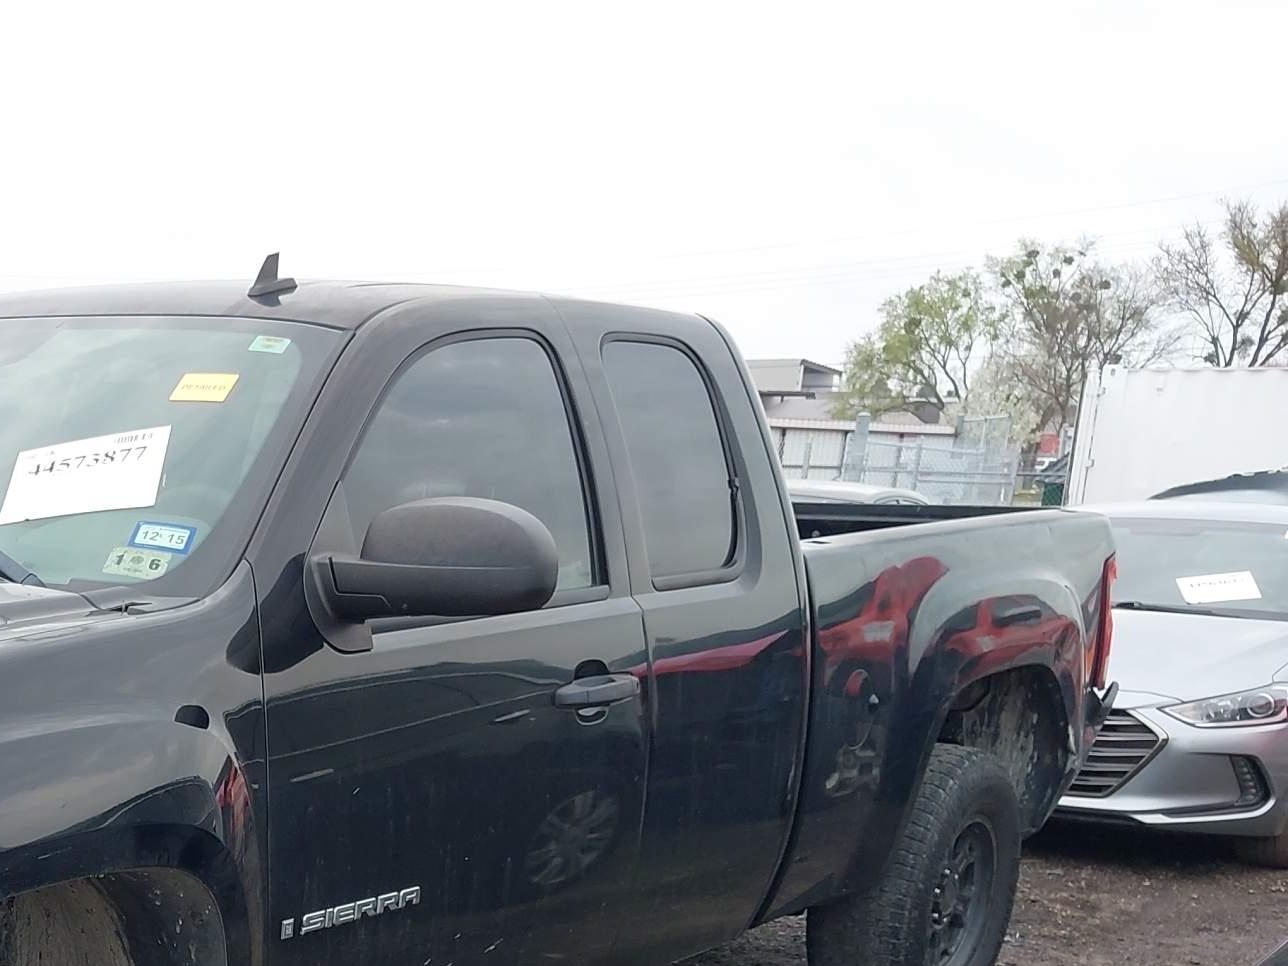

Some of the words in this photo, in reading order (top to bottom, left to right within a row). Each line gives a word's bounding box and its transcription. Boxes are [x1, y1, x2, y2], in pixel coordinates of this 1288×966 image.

[28, 446, 148, 476] 44573877
[148, 558, 162, 571] 6
[299, 886, 420, 936] SIERRA
